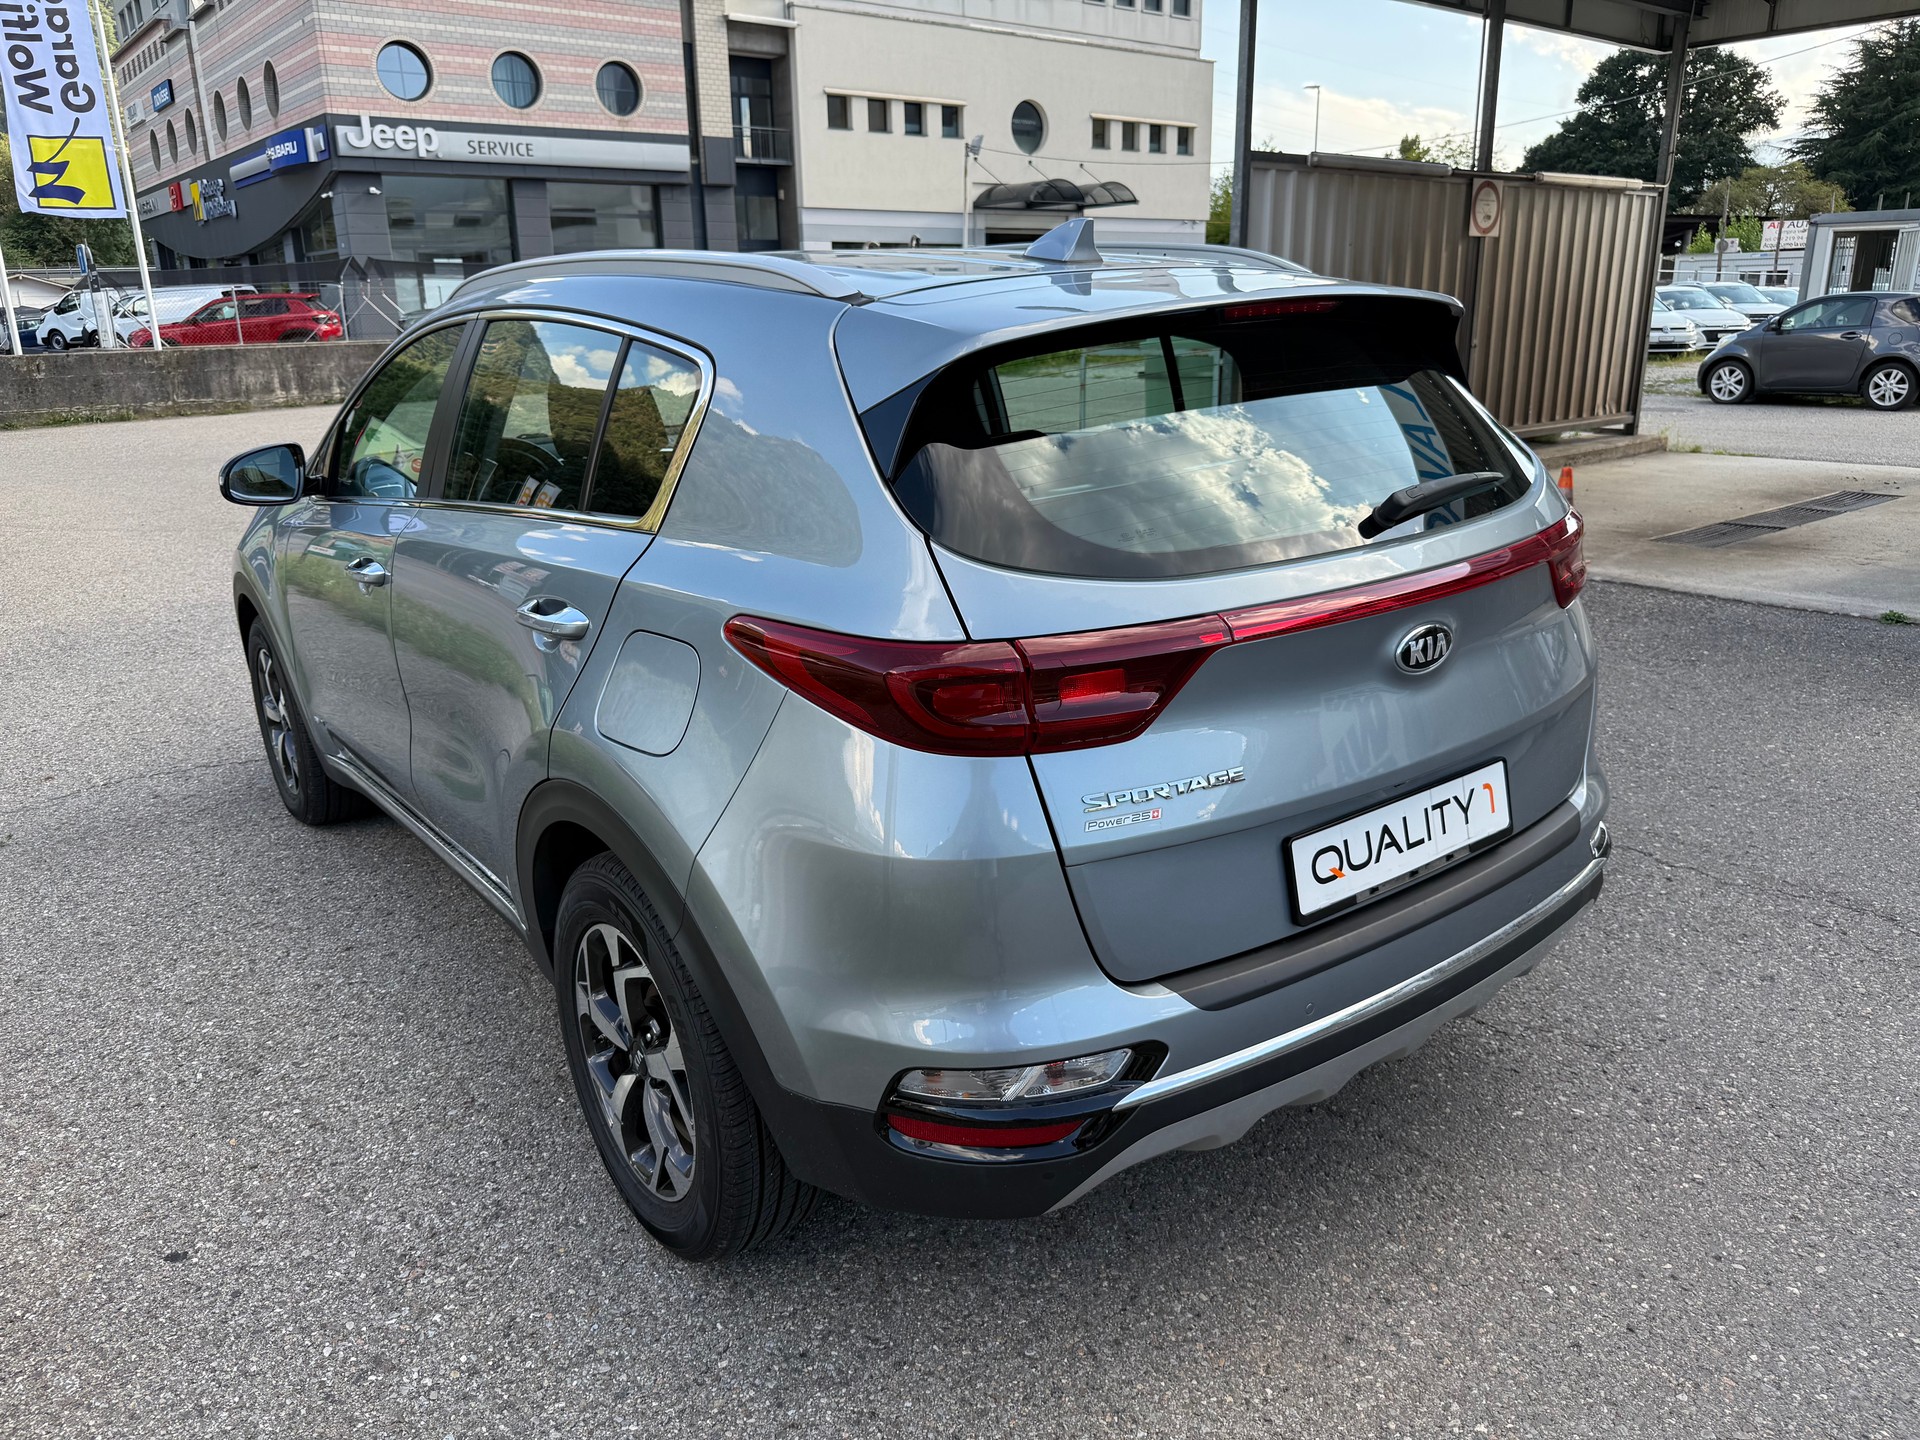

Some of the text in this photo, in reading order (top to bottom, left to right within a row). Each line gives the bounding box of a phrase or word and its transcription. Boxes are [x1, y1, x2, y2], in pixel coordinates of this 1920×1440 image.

[0, 0, 54, 114] Wolfi
[45, 0, 96, 113] Gara
[270, 141, 298, 160] SUBARU
[346, 115, 535, 158] Jeep SERVICE
[1408, 632, 1447, 666] KIA
[1081, 766, 1246, 813] SPORTAGE
[1311, 782, 1496, 885] QUALITY 1
